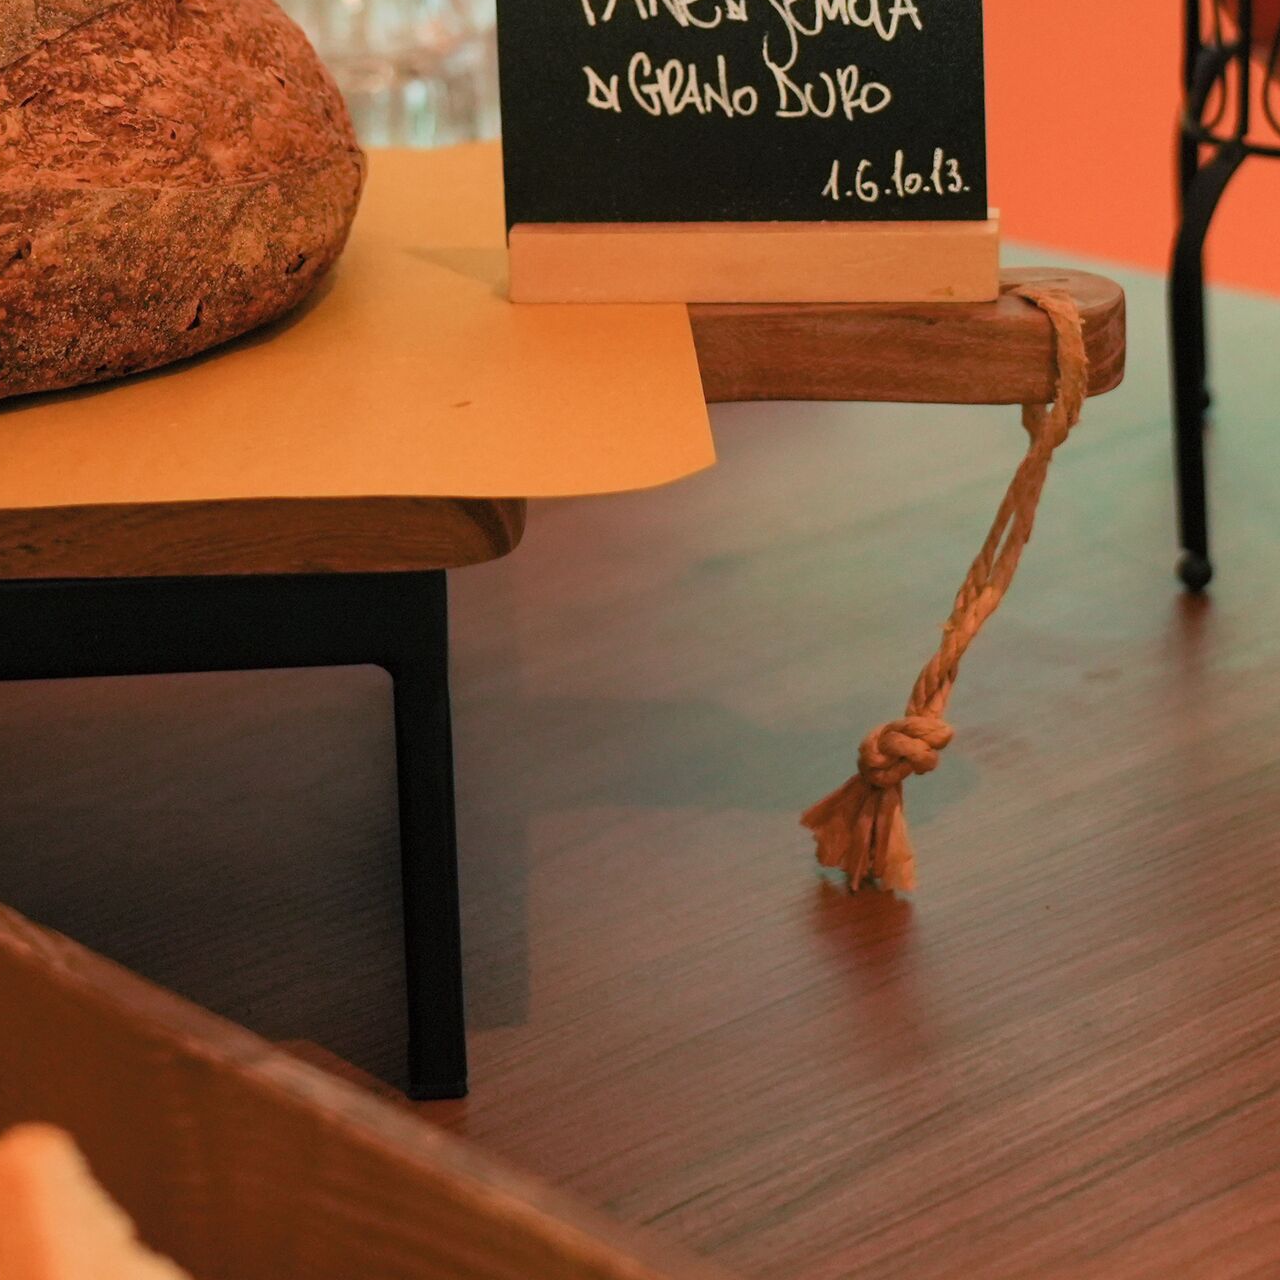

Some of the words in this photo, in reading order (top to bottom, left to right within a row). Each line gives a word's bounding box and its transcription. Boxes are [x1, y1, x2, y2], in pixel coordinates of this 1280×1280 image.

[582, 65, 622, 113] DI
[627, 51, 759, 118] GRANO
[770, 61, 892, 121] DURO
